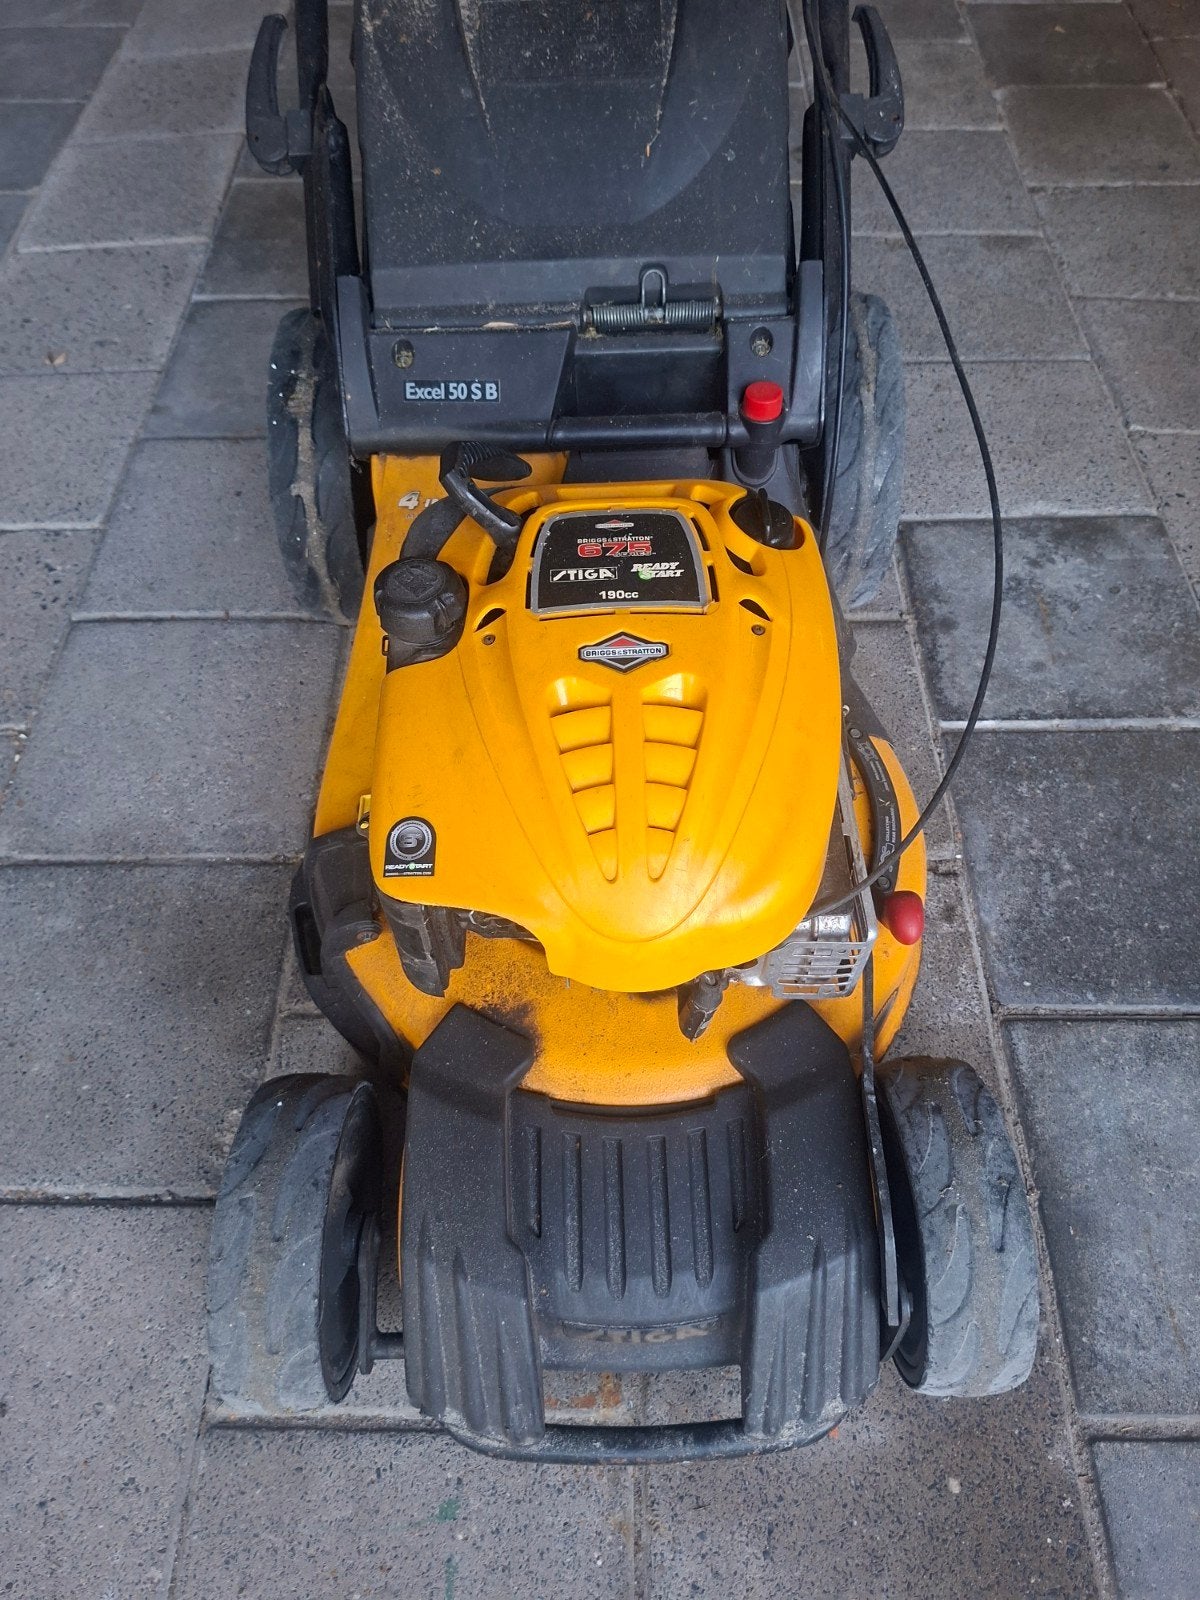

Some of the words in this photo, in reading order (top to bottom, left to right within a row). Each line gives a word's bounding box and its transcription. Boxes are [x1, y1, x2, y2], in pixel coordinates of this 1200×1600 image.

[405, 382, 445, 400] Excel
[448, 382, 468, 400] 50
[471, 382, 482, 400] S
[485, 382, 498, 400] B
[398, 491, 421, 510] 4
[577, 541, 652, 558] 675
[631, 561, 680, 573] READY
[552, 569, 616, 582] STIGA
[640, 569, 684, 580] START
[598, 590, 639, 600] 190cc
